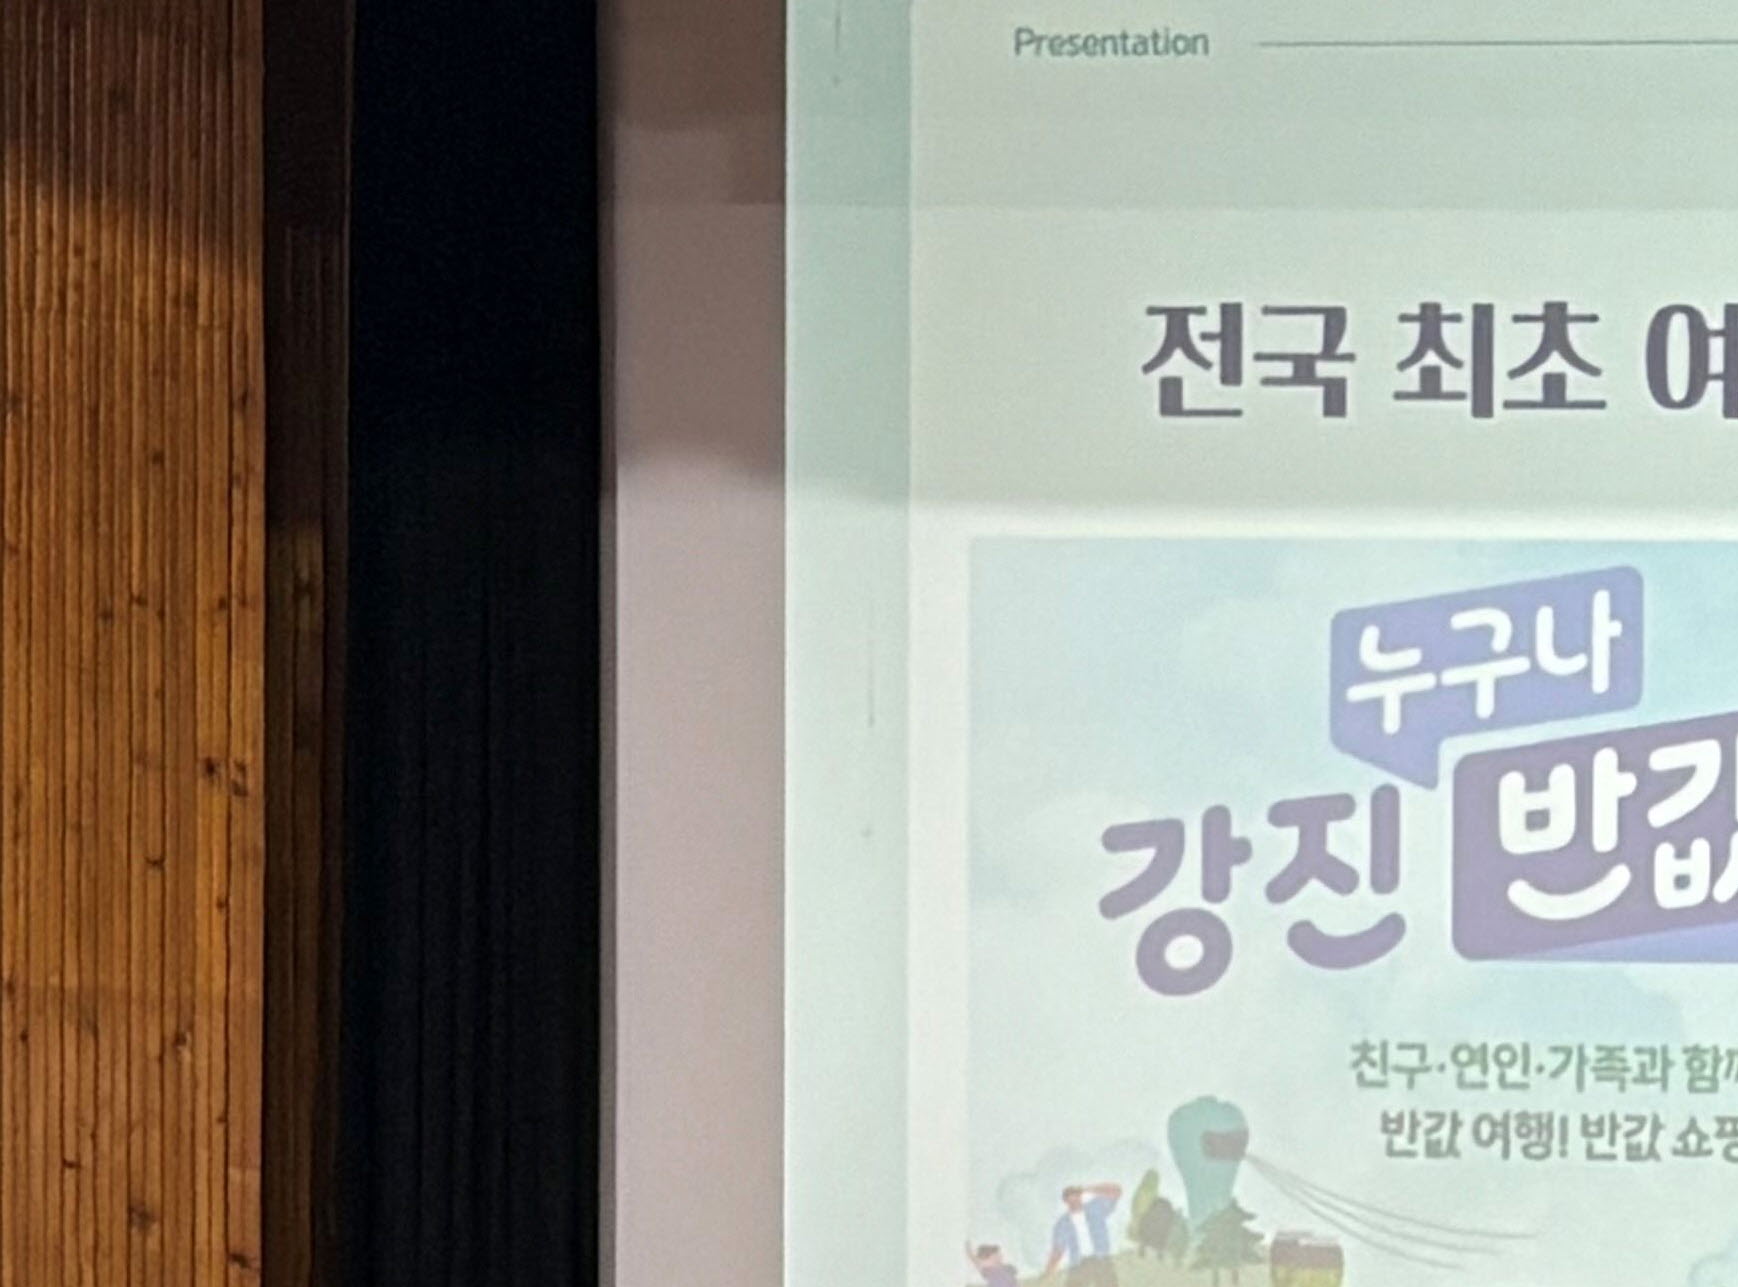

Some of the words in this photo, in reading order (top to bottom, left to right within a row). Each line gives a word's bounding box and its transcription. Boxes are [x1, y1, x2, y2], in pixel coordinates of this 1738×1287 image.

[1014, 27, 1209, 57] Presentation
[1142, 302, 1356, 418] 전국
[1393, 301, 1607, 418] 최초
[1345, 590, 1624, 735] 누구나
[1097, 783, 1407, 998] 강진
[1381, 1109, 1463, 1159] 반값
[1472, 1110, 1568, 1161] 여행!
[1581, 1112, 1664, 1162] 반값
